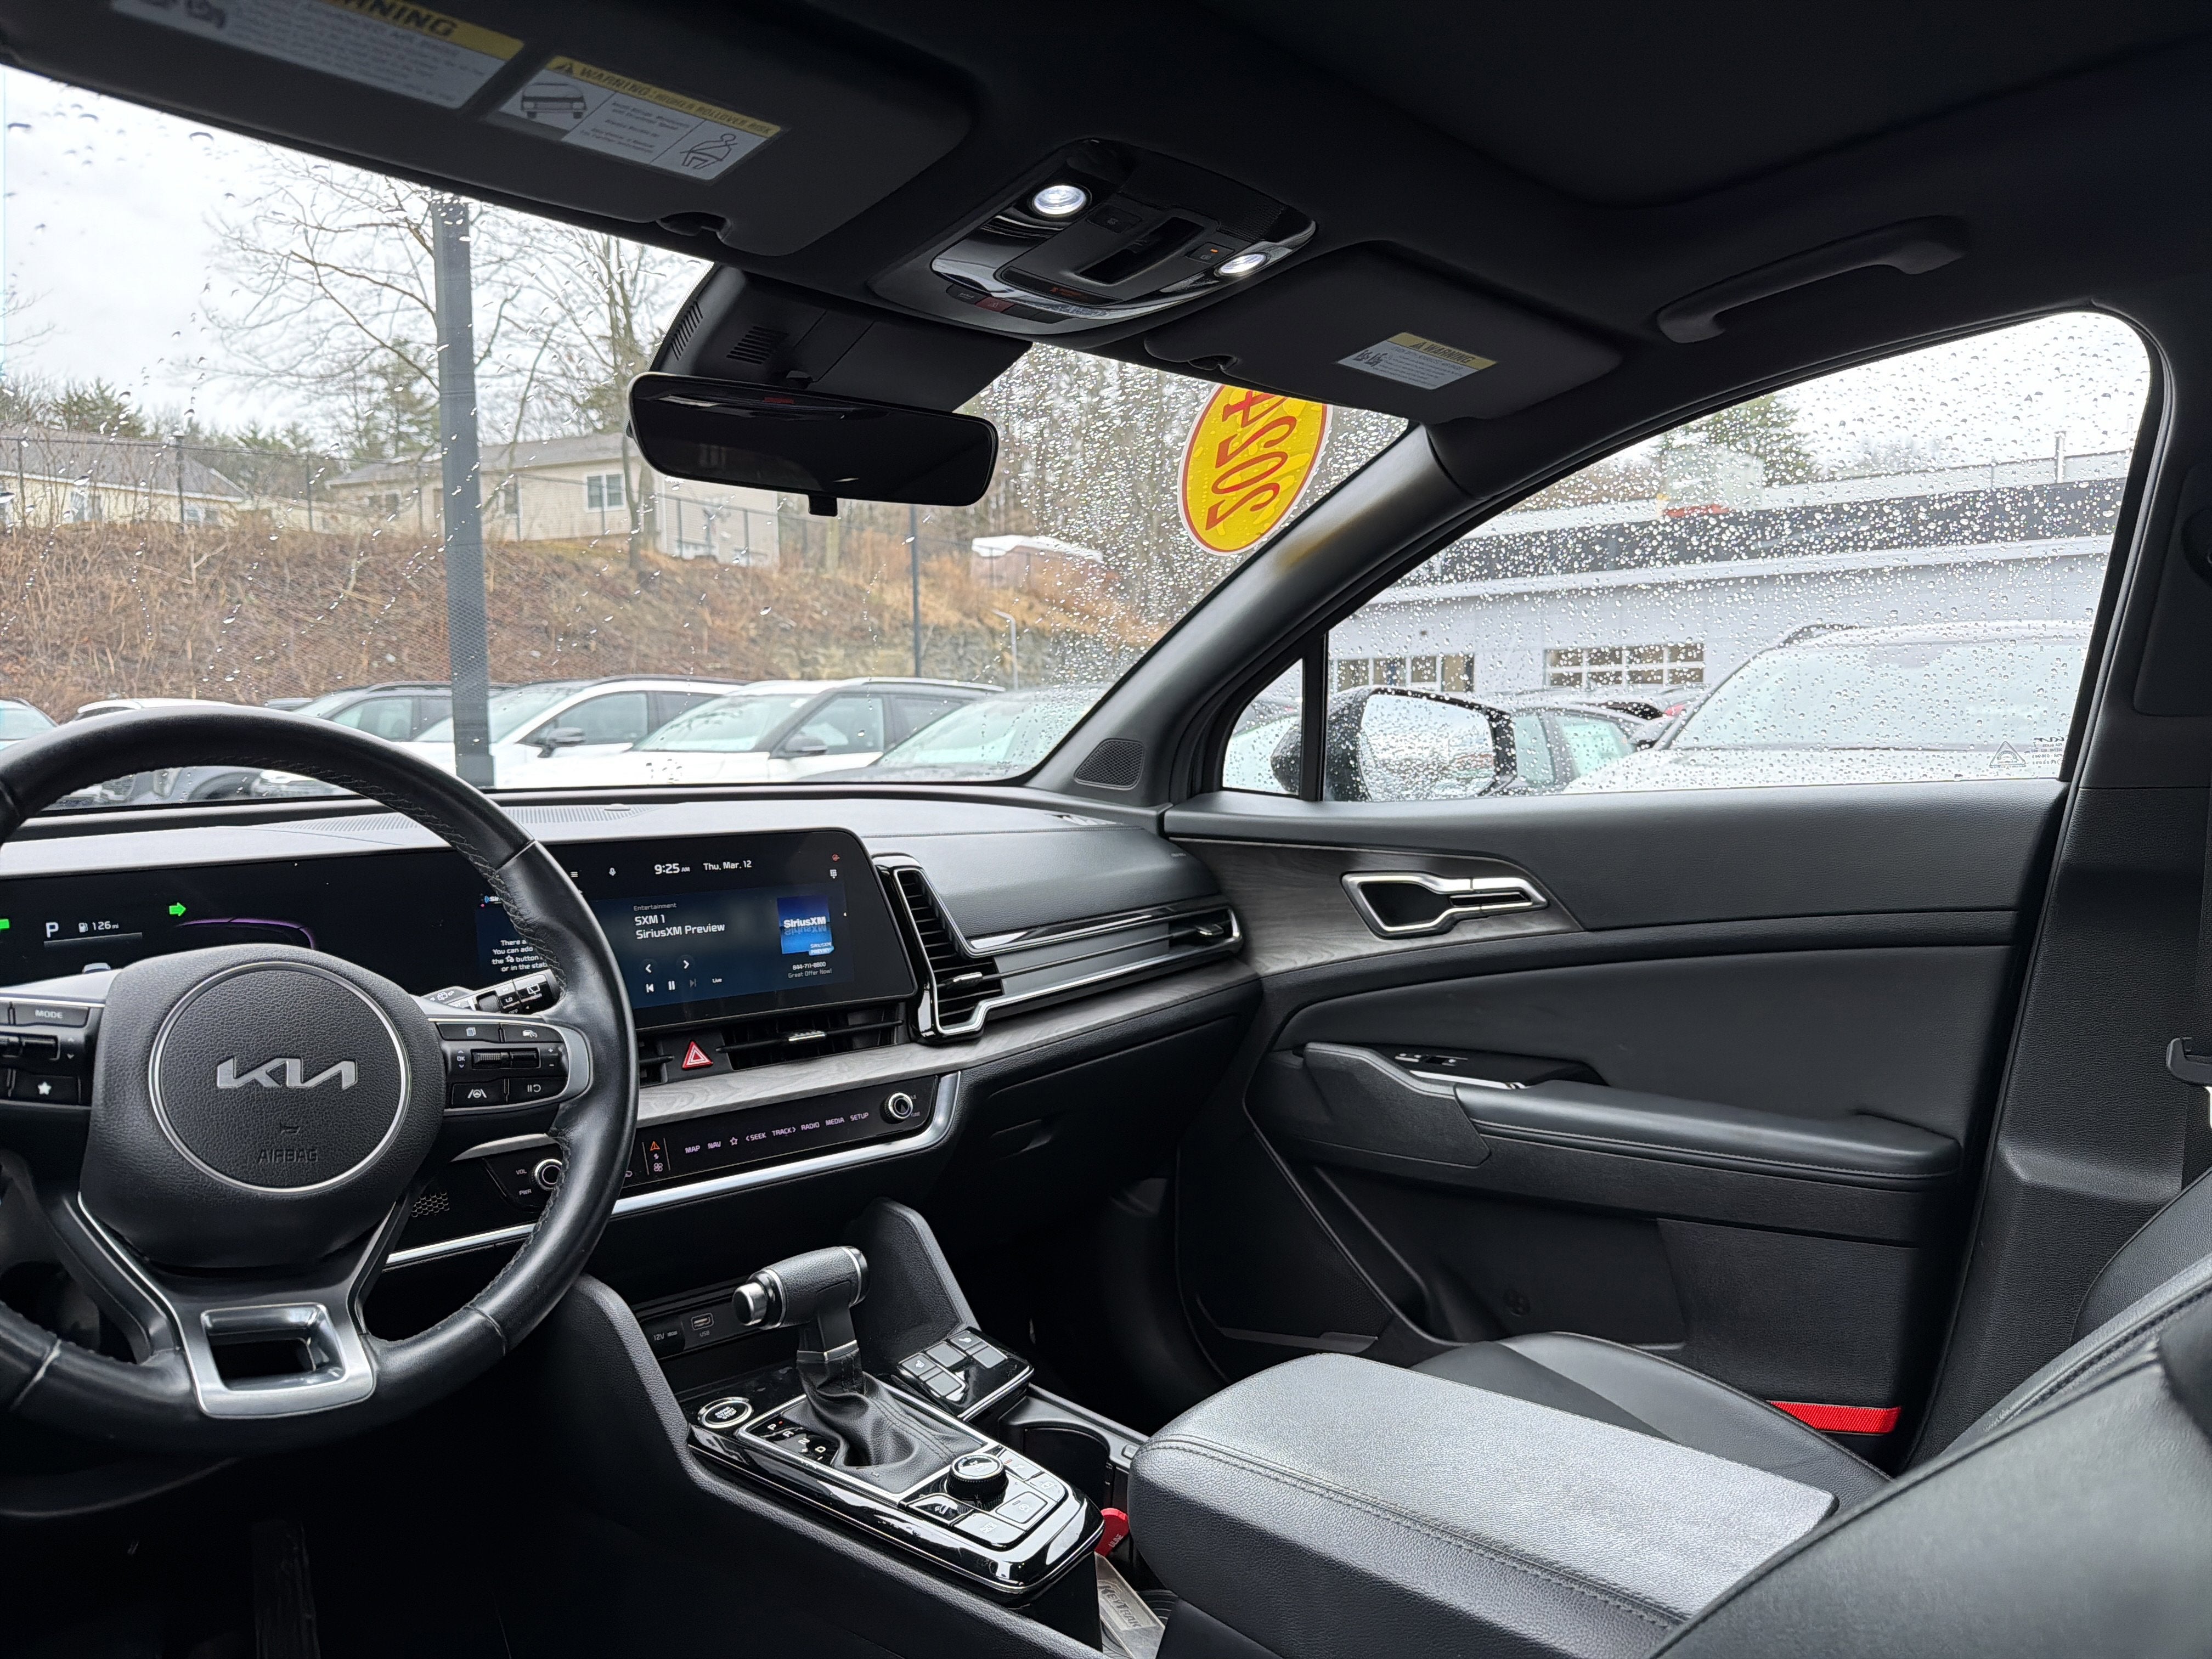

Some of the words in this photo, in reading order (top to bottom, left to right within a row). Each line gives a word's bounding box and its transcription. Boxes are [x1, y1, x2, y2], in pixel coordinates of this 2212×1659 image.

[1424, 343, 1476, 364] WARNING
[654, 863, 680, 874] 9:25
[723, 861, 742, 870] Mar.
[743, 860, 752, 868] 12
[634, 902, 677, 911] Entertainment
[634, 915, 658, 926] SXM
[660, 914, 665, 923] 1
[783, 916, 826, 928] SiriusXM
[46, 922, 59, 938] P
[636, 926, 682, 940] SiriusXM
[685, 923, 725, 935] Preview
[35, 1009, 63, 1019] MODE
[217, 1056, 358, 1090] KIA
[800, 1121, 820, 1131] RADIO
[825, 1116, 845, 1126] MEDIA
[850, 1112, 869, 1121] SETUP
[685, 1144, 701, 1154] MAP
[707, 1141, 722, 1150] NAV
[258, 1148, 319, 1164] AIRBAG
[653, 1332, 665, 1341] 12V
